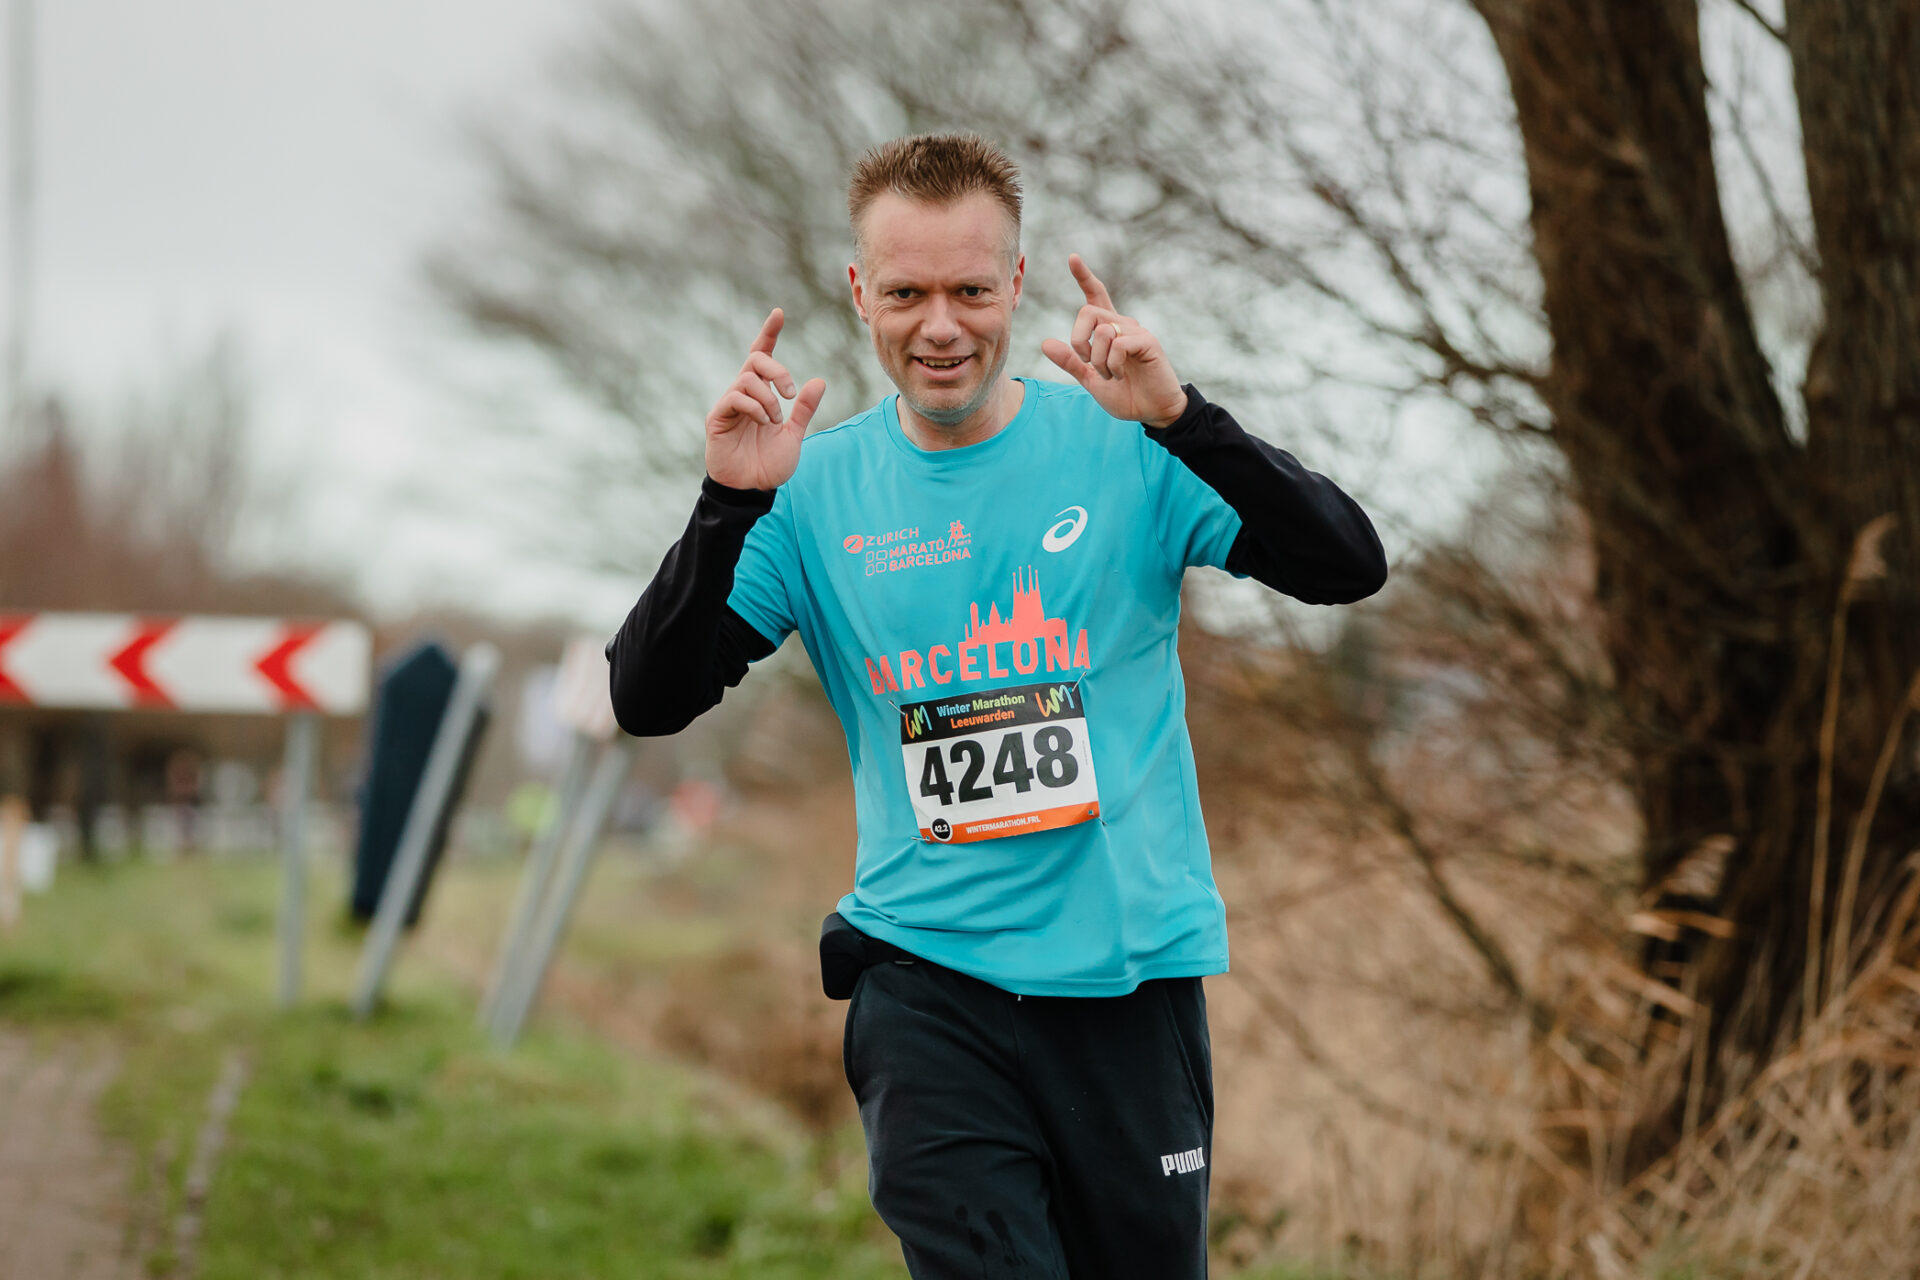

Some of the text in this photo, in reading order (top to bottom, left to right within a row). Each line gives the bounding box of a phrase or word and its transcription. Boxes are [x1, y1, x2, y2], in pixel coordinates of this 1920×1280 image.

[865, 527, 919, 547] ZURICH
[889, 537, 944, 559] MARATÓ
[889, 547, 971, 572] BARCELONA
[865, 629, 1091, 695] BARCELONA
[936, 694, 1026, 718] Winter Marathon
[950, 709, 1015, 729] Leeuwarden
[920, 725, 1079, 806] 4248
[965, 815, 1041, 834] WINTERMARATHON.FRL
[1160, 1146, 1206, 1177] PUMA
